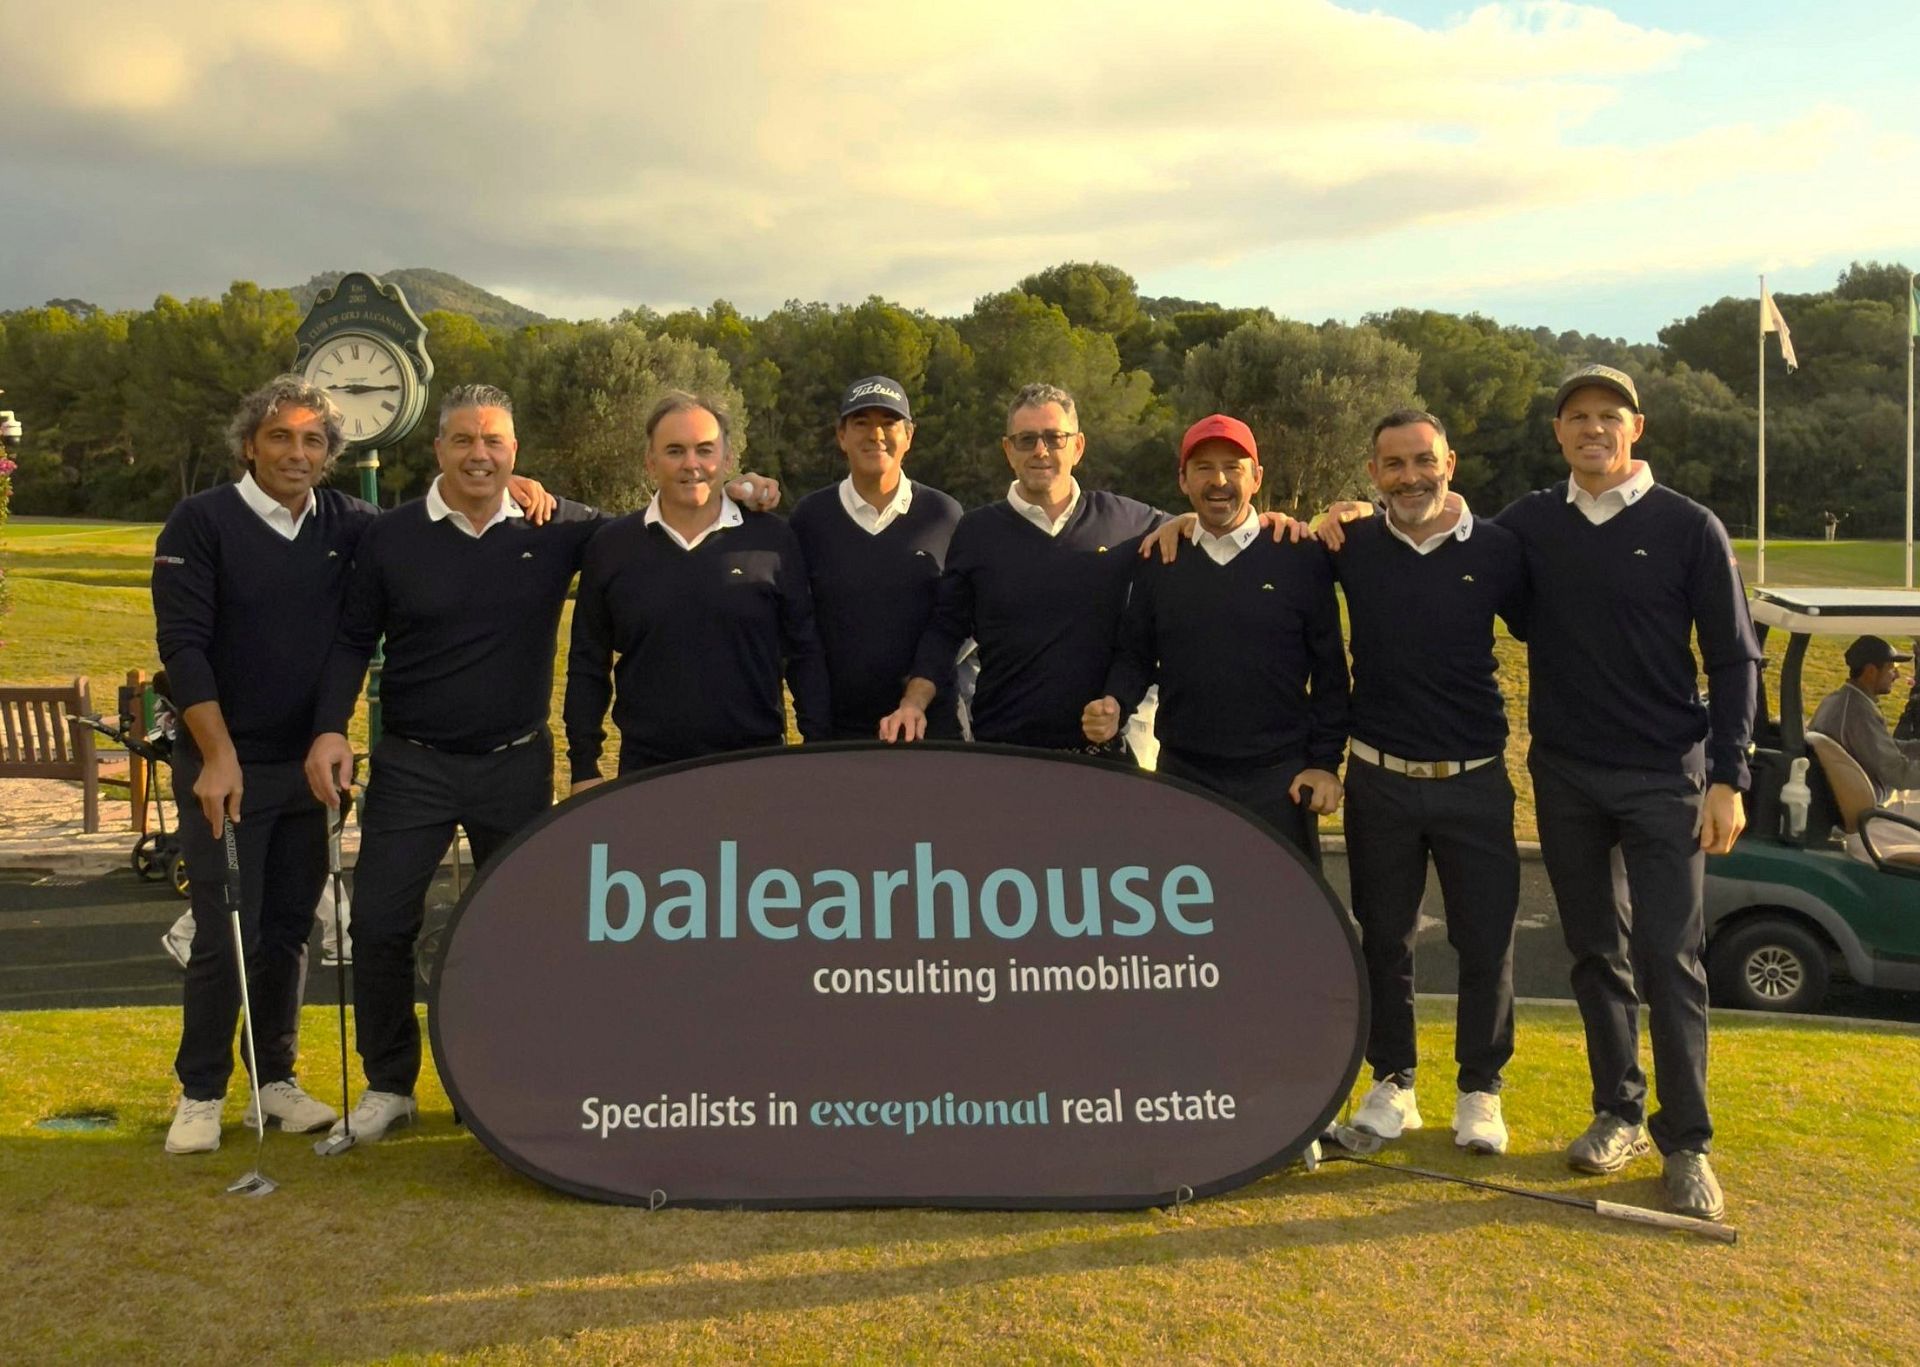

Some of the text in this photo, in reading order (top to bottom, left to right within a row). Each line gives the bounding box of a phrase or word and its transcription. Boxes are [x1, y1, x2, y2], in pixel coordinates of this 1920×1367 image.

[588, 840, 1215, 942] balearhouse
[813, 955, 1220, 1003] consulting inmobiliario
[581, 1088, 1236, 1139] Specialists in exceptional real estate
